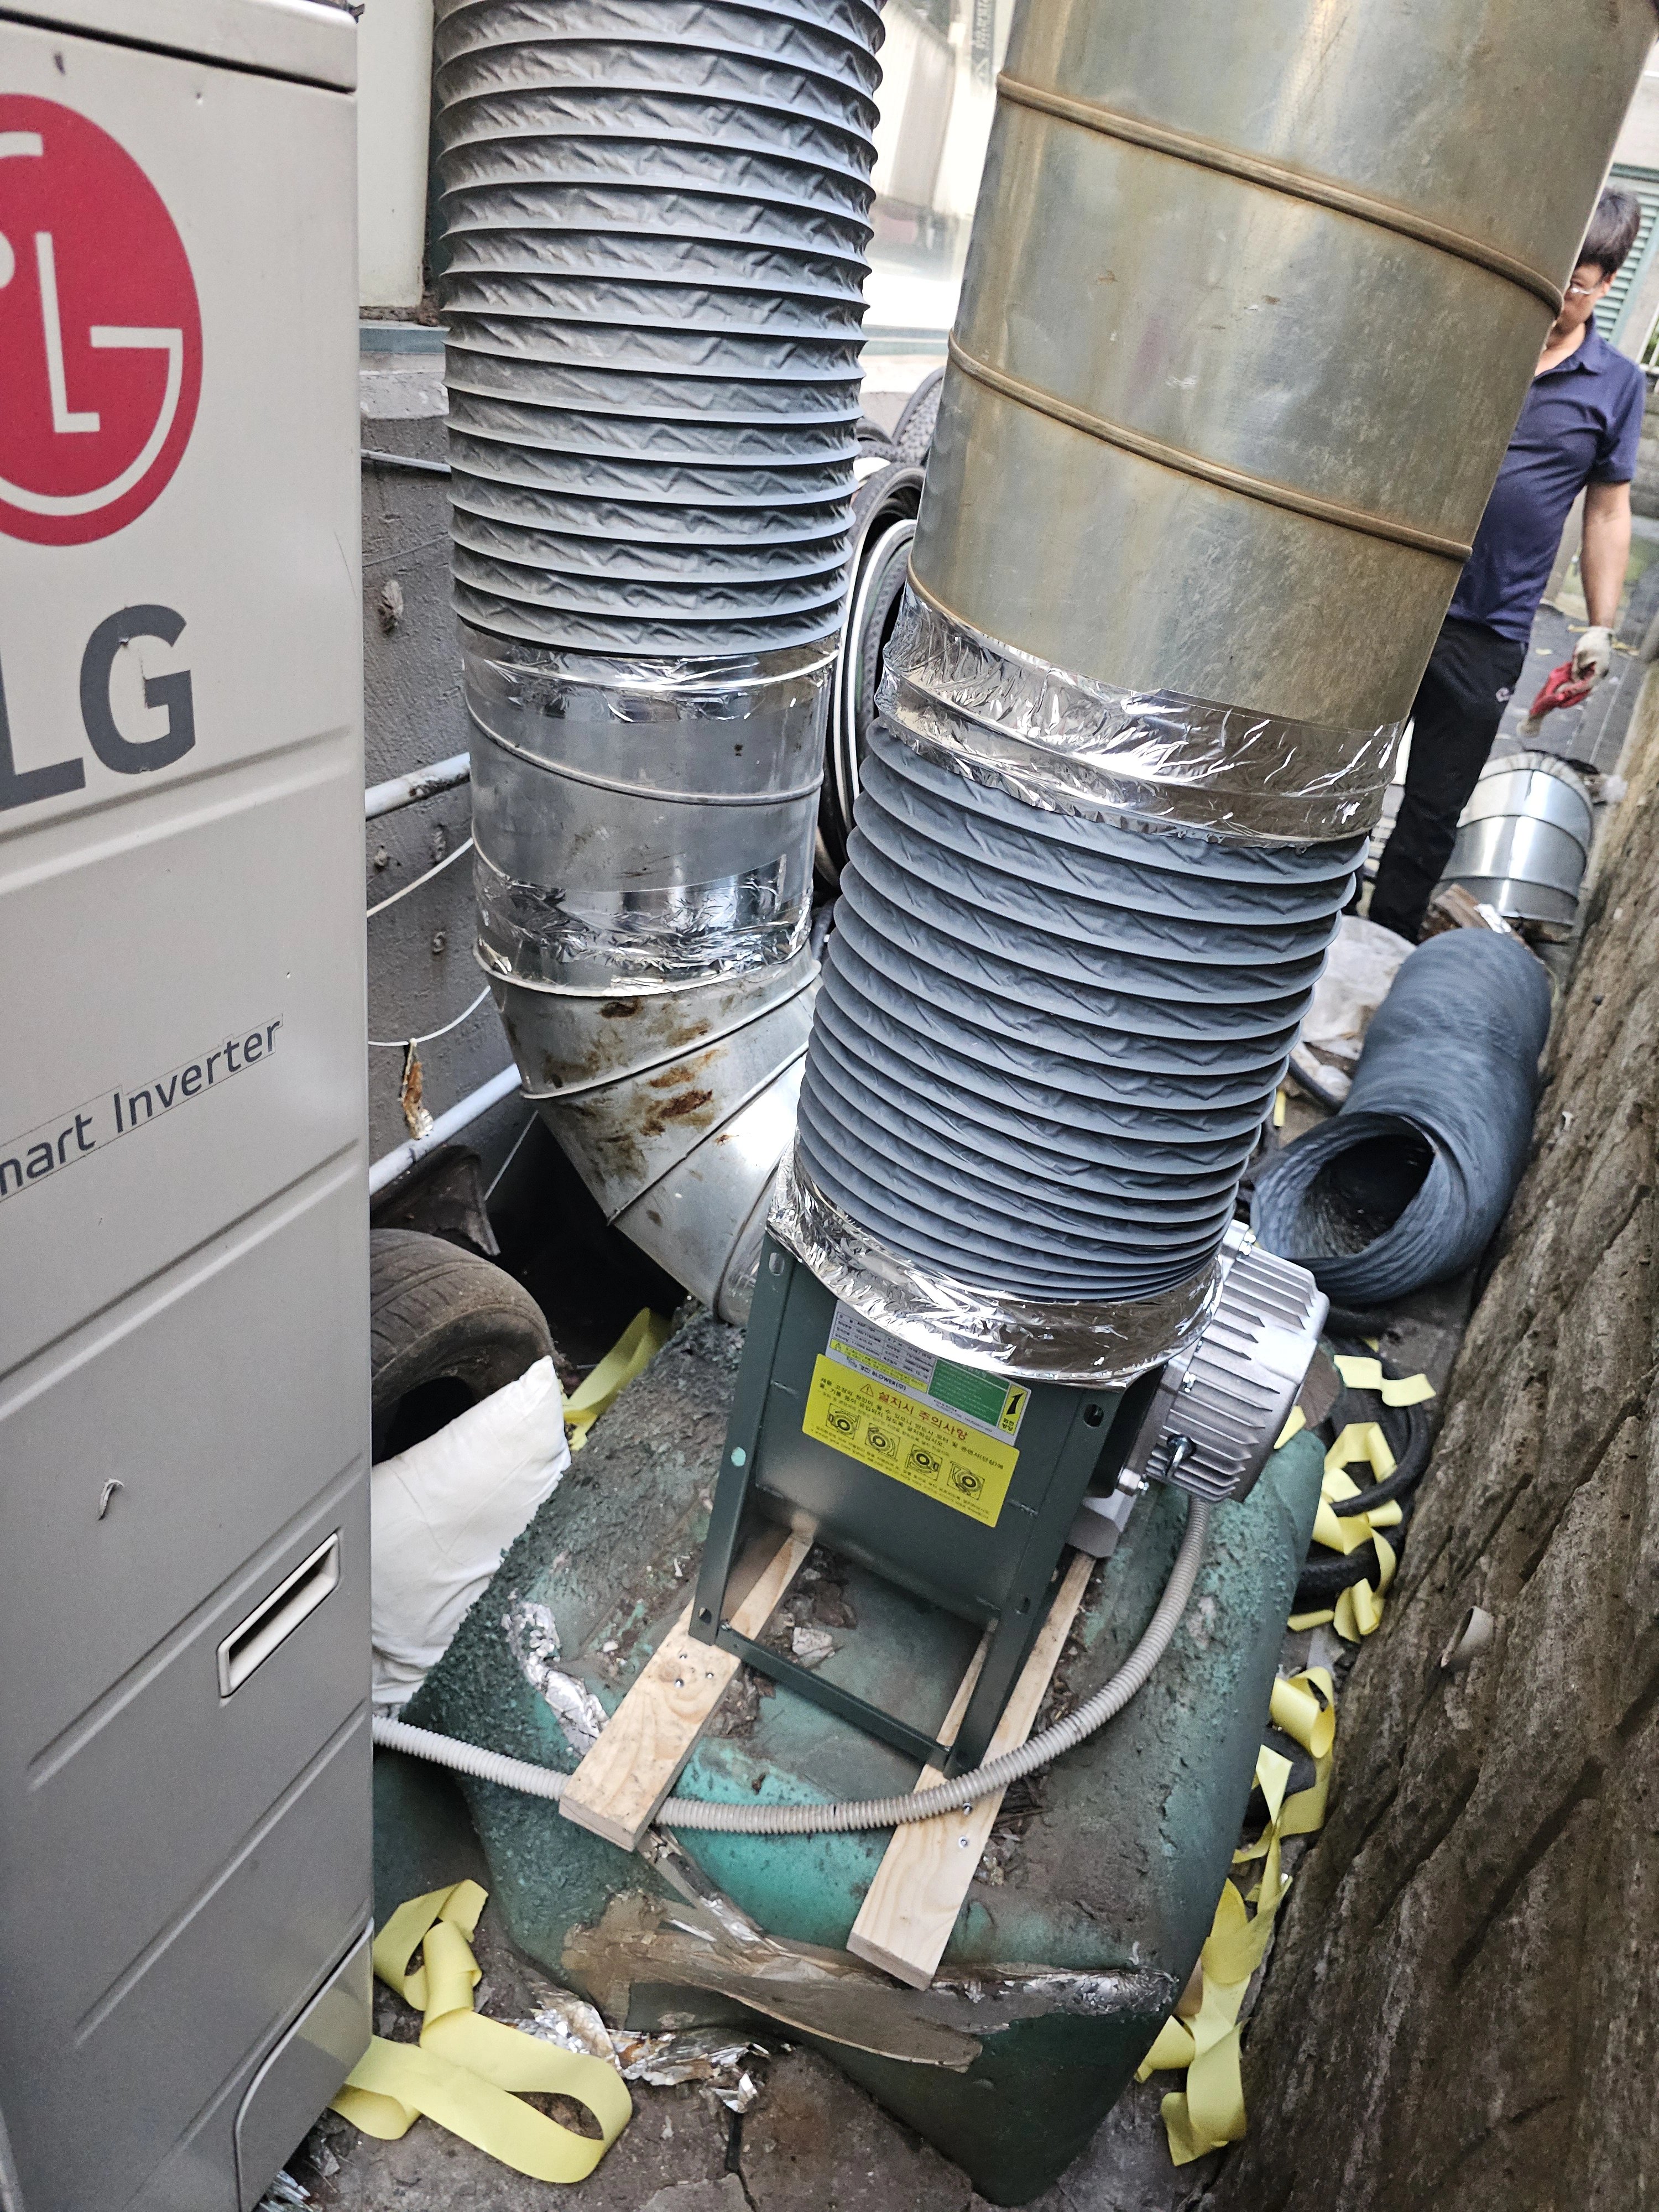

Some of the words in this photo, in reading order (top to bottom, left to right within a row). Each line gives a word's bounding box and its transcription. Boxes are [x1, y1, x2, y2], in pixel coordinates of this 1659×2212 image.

[0, 604, 196, 811] LG
[114, 1019, 281, 1133] Inverter
[872, 1370, 906, 1391] BLOWER(주)
[894, 1412, 912, 1425] 있으니
[917, 1409, 968, 1441] 주의사항
